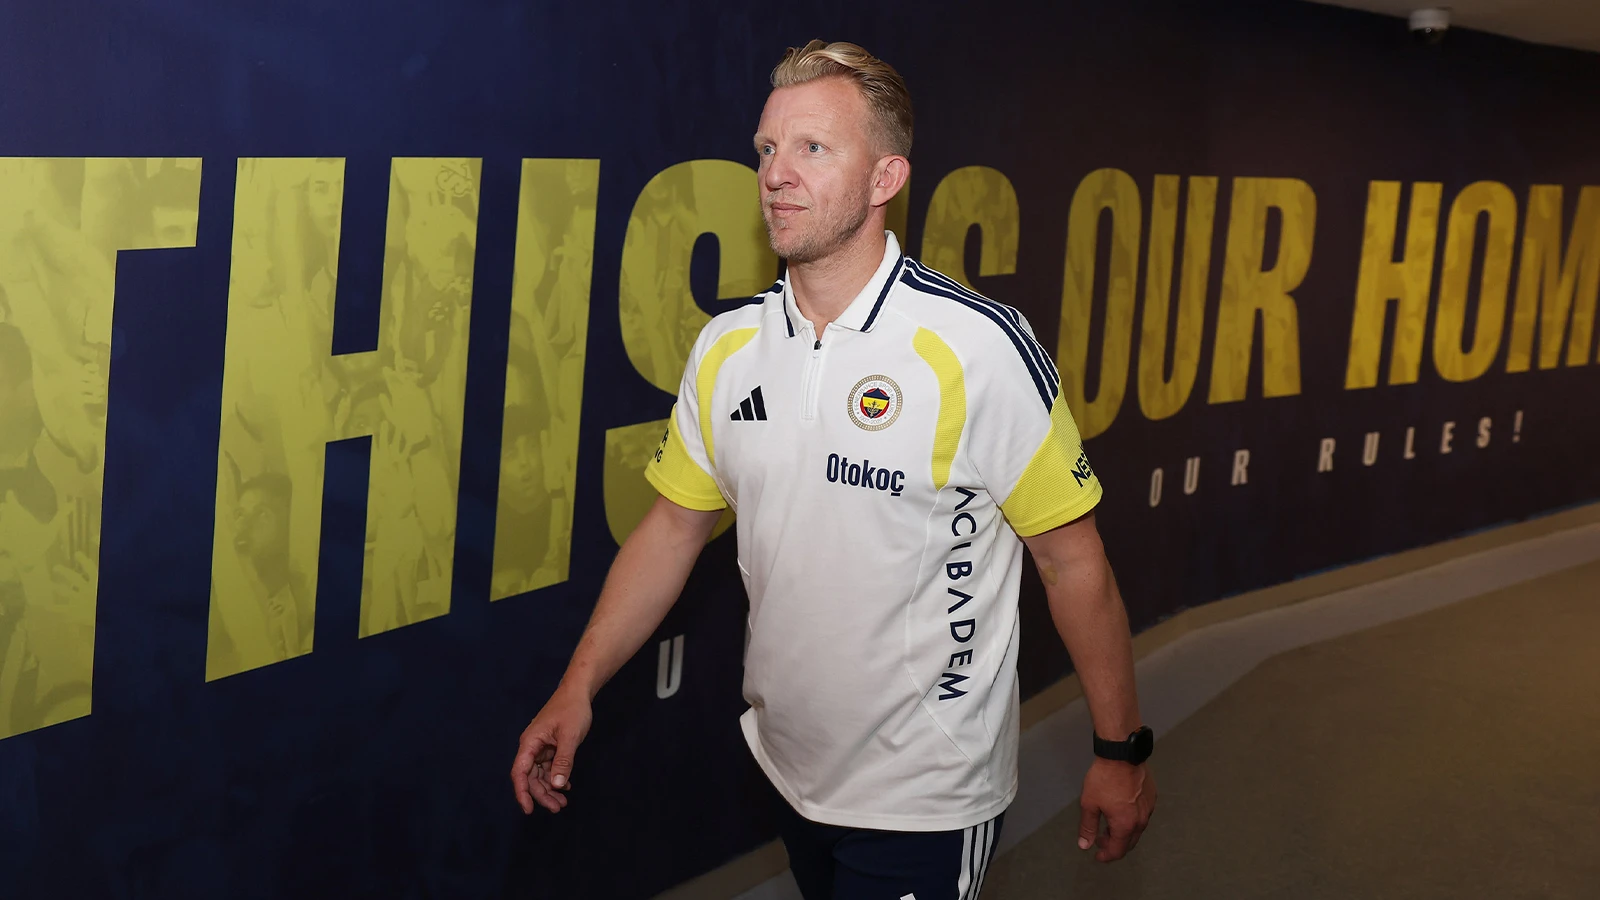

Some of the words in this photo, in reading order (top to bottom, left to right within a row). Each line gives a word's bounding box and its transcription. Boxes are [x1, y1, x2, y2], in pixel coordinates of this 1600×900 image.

[1056, 168, 1317, 441] OUR
[1345, 180, 1600, 390] HOM
[826, 453, 905, 497] Otokoç
[1149, 450, 1251, 508] OUR
[1317, 410, 1524, 473] RULES!
[938, 486, 977, 701] ACIBADEM
